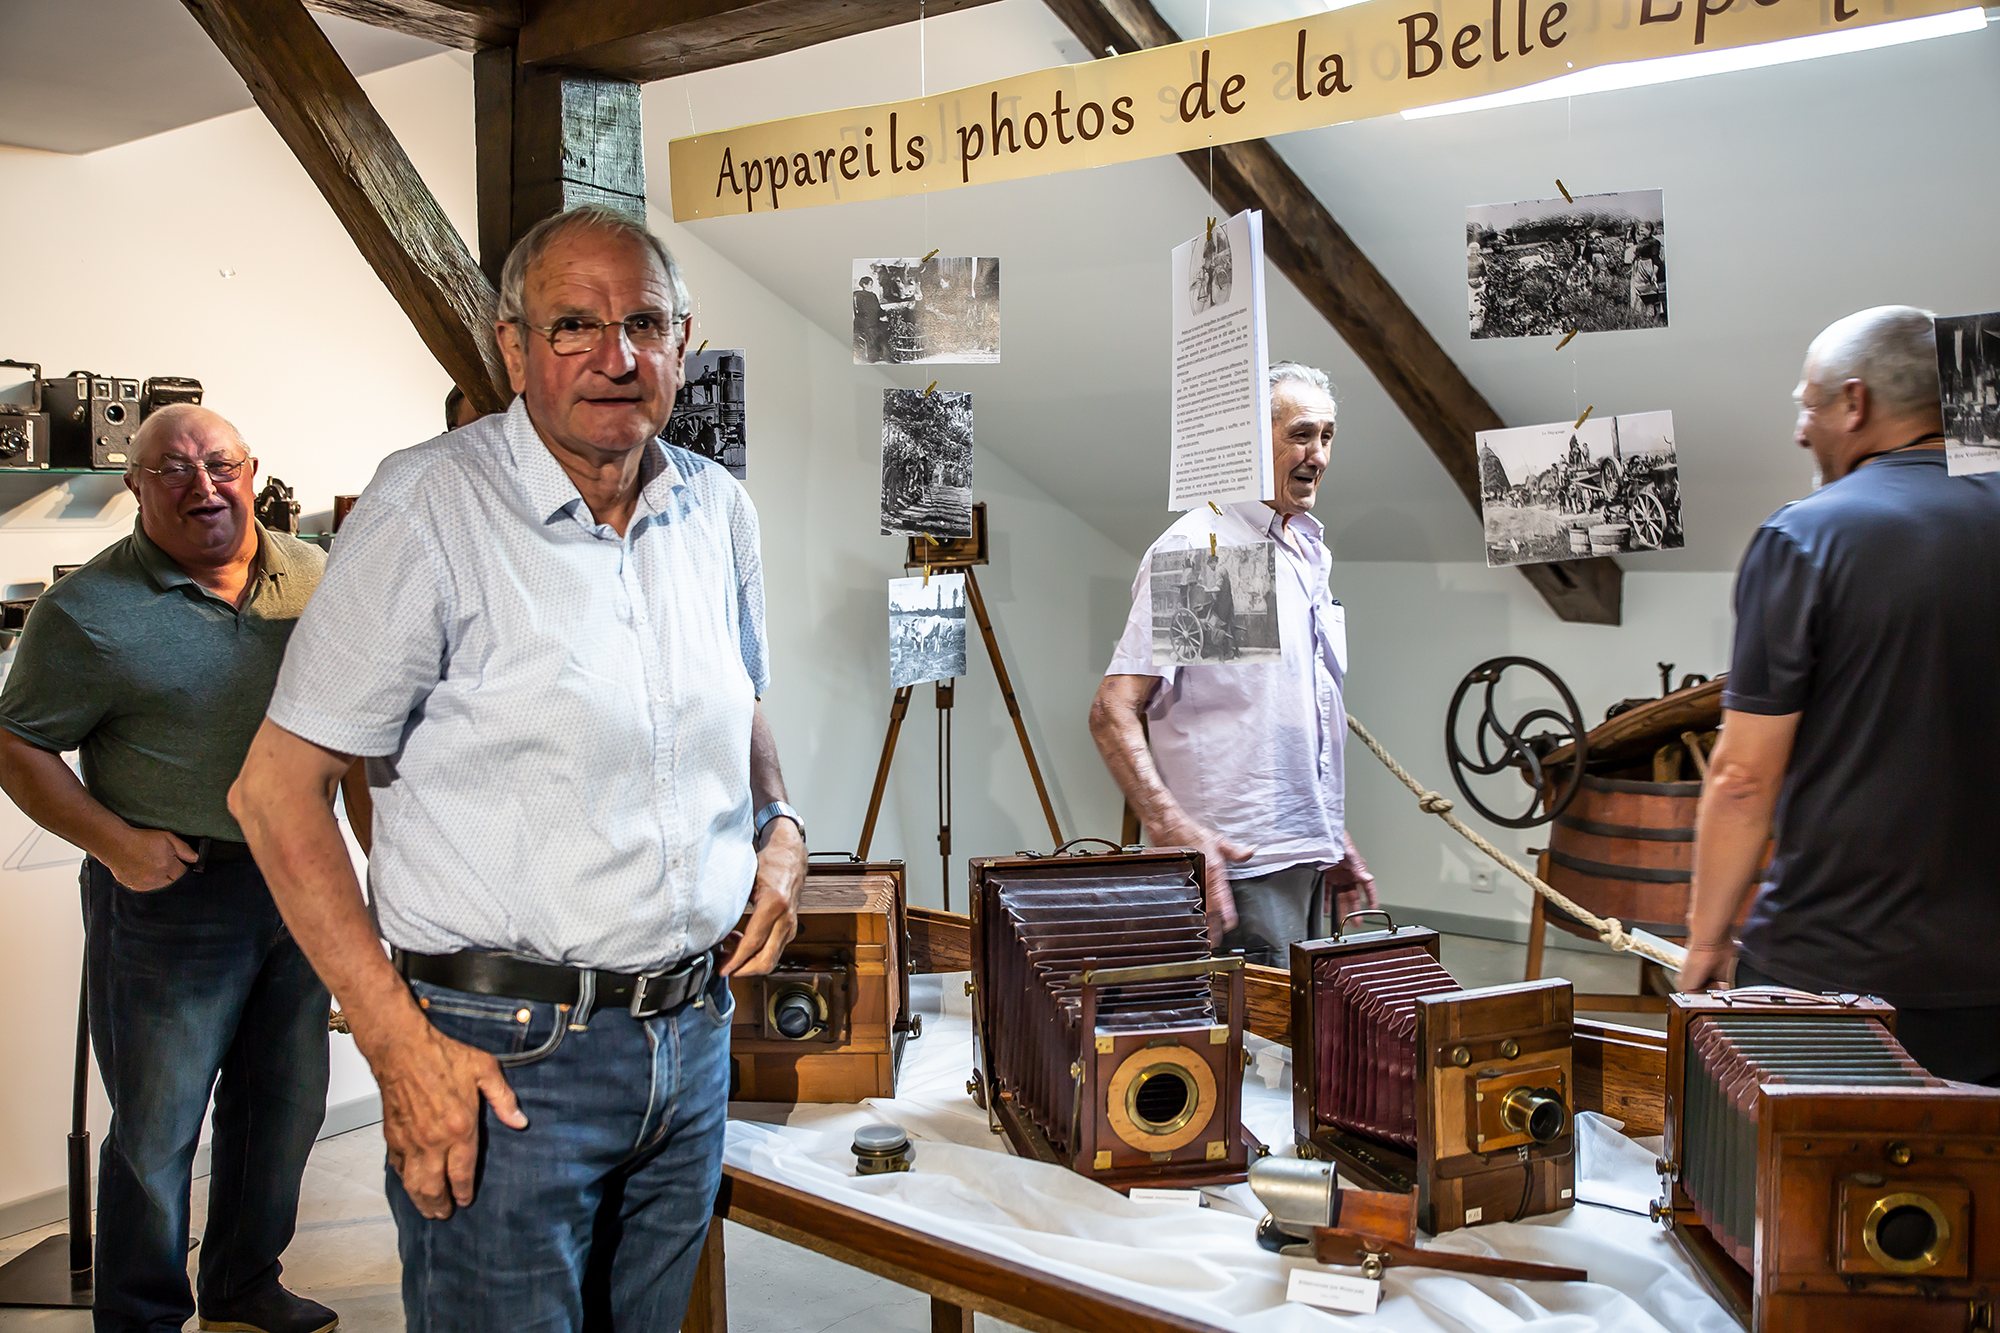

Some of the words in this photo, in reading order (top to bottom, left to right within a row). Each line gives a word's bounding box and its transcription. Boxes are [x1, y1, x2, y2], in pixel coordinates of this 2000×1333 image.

[715, 112, 925, 211] Appareils
[956, 89, 1135, 184] photos
[1179, 49, 1246, 123] de
[1296, 28, 1353, 102] la
[1397, 0, 1568, 80] Belle
